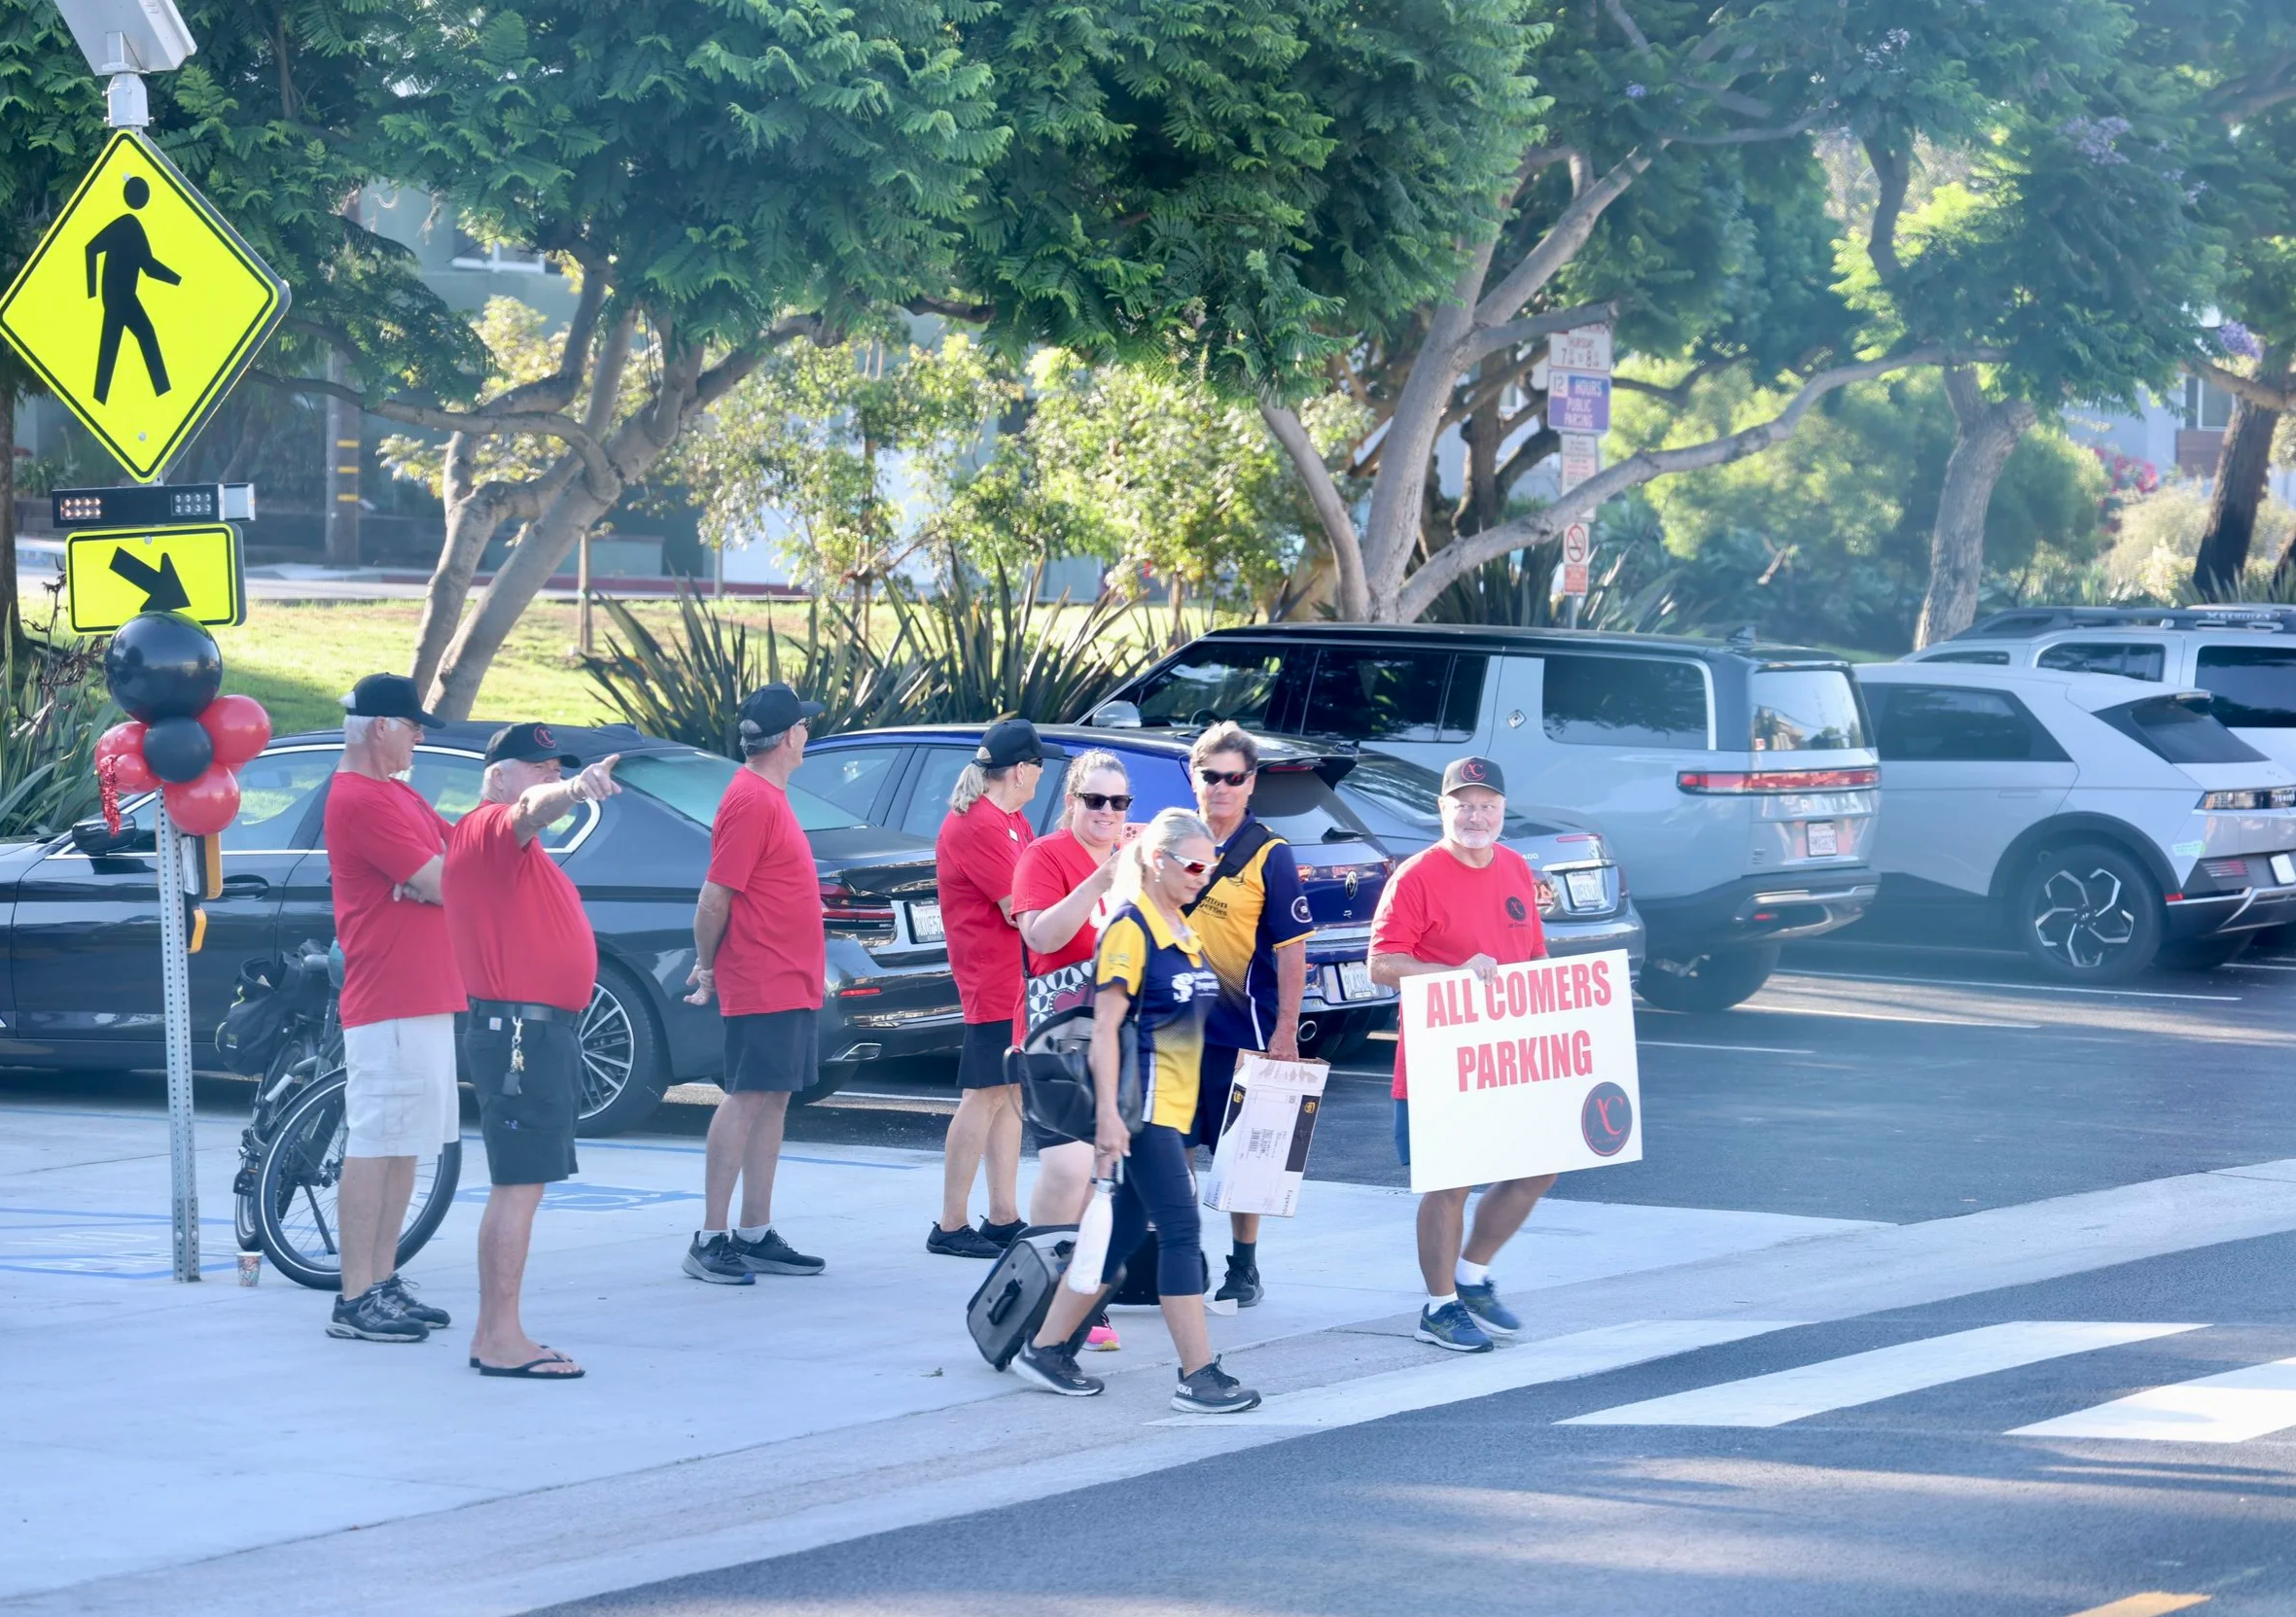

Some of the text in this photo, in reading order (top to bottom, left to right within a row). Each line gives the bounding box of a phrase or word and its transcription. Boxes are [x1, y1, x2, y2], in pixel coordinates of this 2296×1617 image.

[1553, 374, 1602, 397] 12 HOURS
[1566, 398, 1592, 413] PUBLIC
[1564, 412, 1593, 428] PARKING
[1427, 961, 1611, 1028] ALL COMERS
[1457, 1030, 1593, 1092] PARKING
